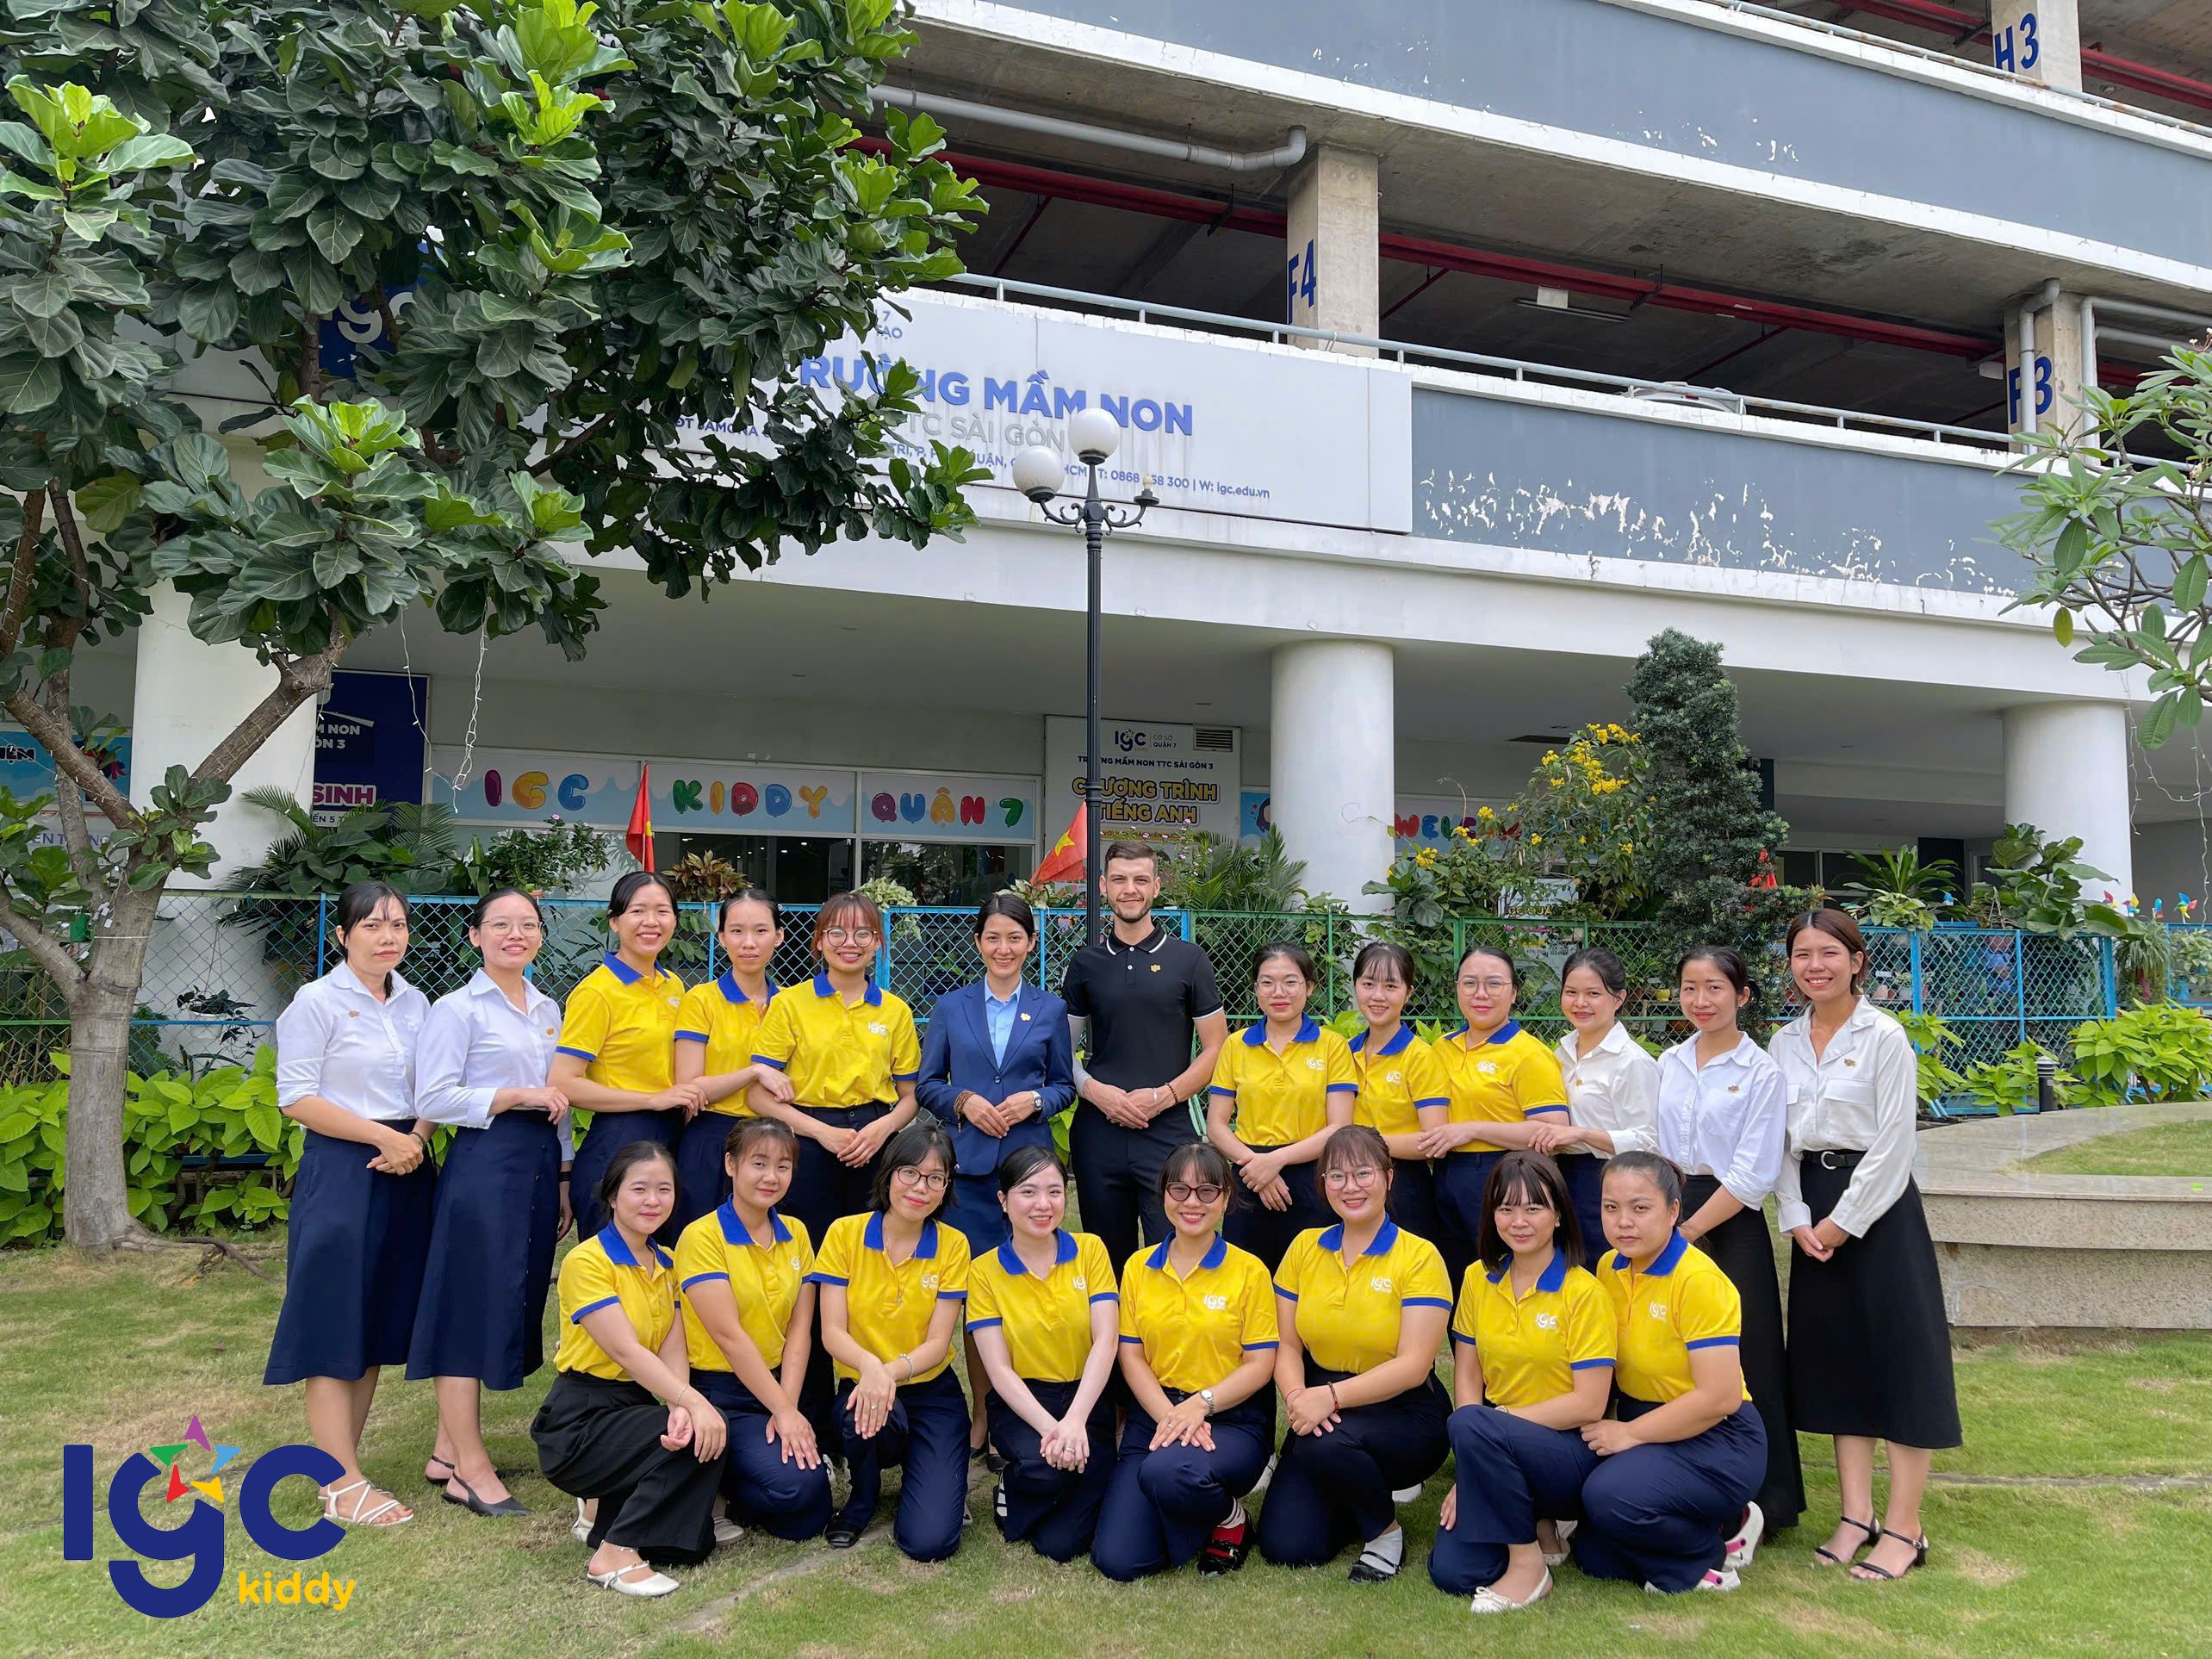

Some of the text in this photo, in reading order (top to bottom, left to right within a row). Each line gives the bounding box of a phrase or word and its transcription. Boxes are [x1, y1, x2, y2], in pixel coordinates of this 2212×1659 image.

[1288, 239, 1317, 326] F4
[1100, 393, 1193, 436] NON
[907, 411, 1066, 453] TC SÀI GÒN
[1110, 469, 1140, 483] 0868
[1167, 476, 1190, 488] 300
[1199, 479, 1214, 492] W:
[327, 724, 360, 735] NON
[315, 736, 345, 749] ÒN 3
[1077, 755, 1114, 765] TRNG
[313, 785, 375, 805] SINH
[484, 769, 589, 811] IGC
[672, 779, 829, 819] KIDDY
[998, 798, 1024, 828] 7
[1072, 776, 1220, 802] CƯƠNG TRÌNH
[1154, 804, 1198, 824] ANH
